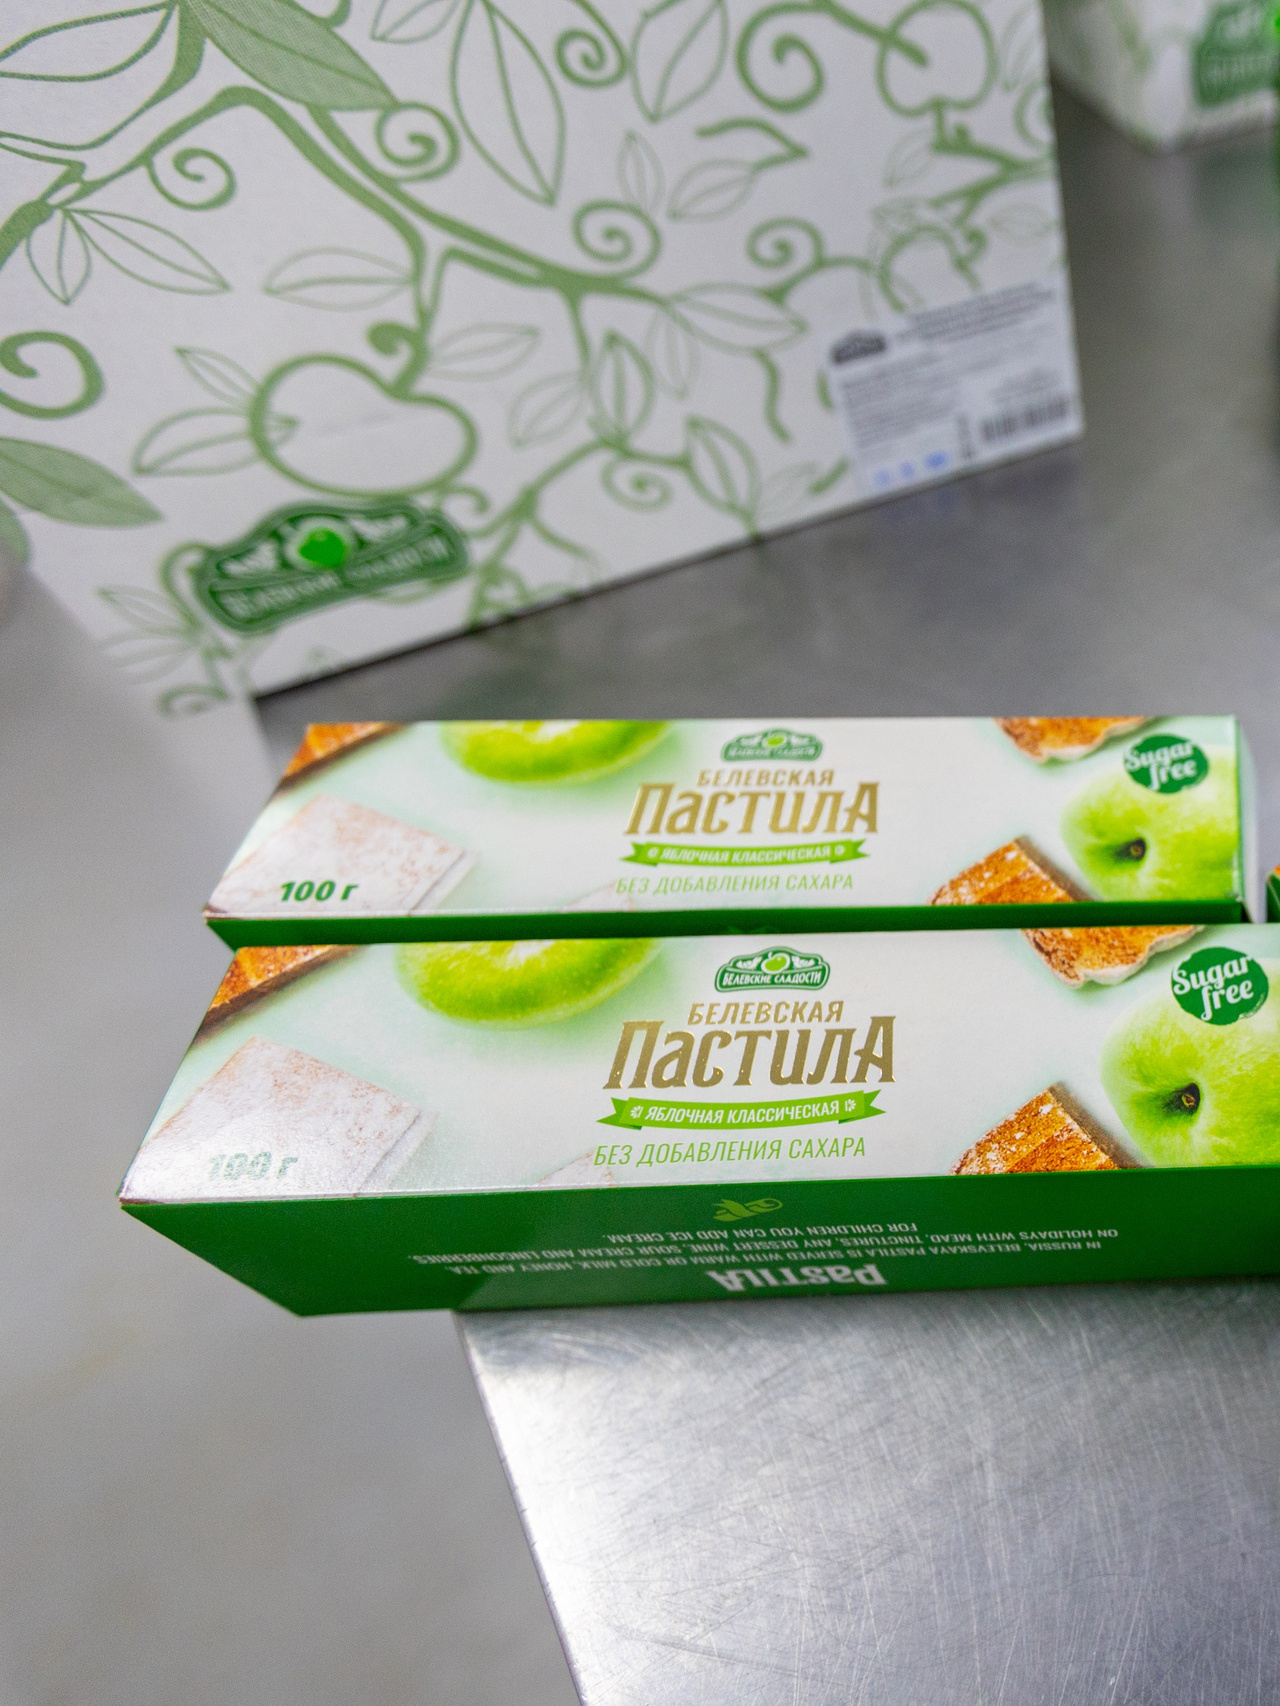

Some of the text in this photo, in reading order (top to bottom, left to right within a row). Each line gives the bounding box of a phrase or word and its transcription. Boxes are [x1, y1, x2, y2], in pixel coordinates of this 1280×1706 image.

[1124, 741, 1194, 771] Sugar
[696, 769, 834, 786] БЕЛЕВСКАЯ
[1149, 760, 1197, 791] free
[660, 845, 831, 863] ЯБЛОЧНАЯ КЛАССИЧЕСКАЯ
[616, 873, 853, 896] БЕЗ ДОБАВЛЕНИЯ САХАРА
[280, 880, 336, 902] 100
[722, 970, 822, 986] БЕЛЕВСКИЕ СЛАДОСТИ
[1171, 955, 1251, 995] Sugar
[1200, 980, 1254, 1021] free
[687, 1001, 844, 1026] БЕЛЕВСКАЯ
[645, 1100, 840, 1124] ЯБЛОЧНАЯ КЛАССИЧЕСКАЯ
[594, 1137, 866, 1167] БЕЗ ДОБАВЛЕНИЯ САХАРА
[207, 1151, 272, 1181] 100
[733, 1228, 766, 1238] CAN
[769, 1226, 804, 1237] YOU
[806, 1224, 883, 1235] CHILDREN
[887, 1223, 918, 1232] FOR
[665, 1231, 694, 1241] ICE
[696, 1229, 729, 1240] ADD
[976, 1231, 1015, 1242] WITH
[1019, 1230, 1093, 1240] HOLIDAYS
[1097, 1229, 1118, 1238] ON
[733, 1240, 798, 1251] DESSERT
[804, 1238, 832, 1249] ANY
[929, 1243, 1021, 1254] BELEVSKAYA
[1086, 1241, 1102, 1249] IN
[742, 1252, 783, 1262] WITH
[787, 1250, 844, 1260] SERVED
[847, 1249, 863, 1259] IS
[866, 1247, 926, 1257] PASTILA
